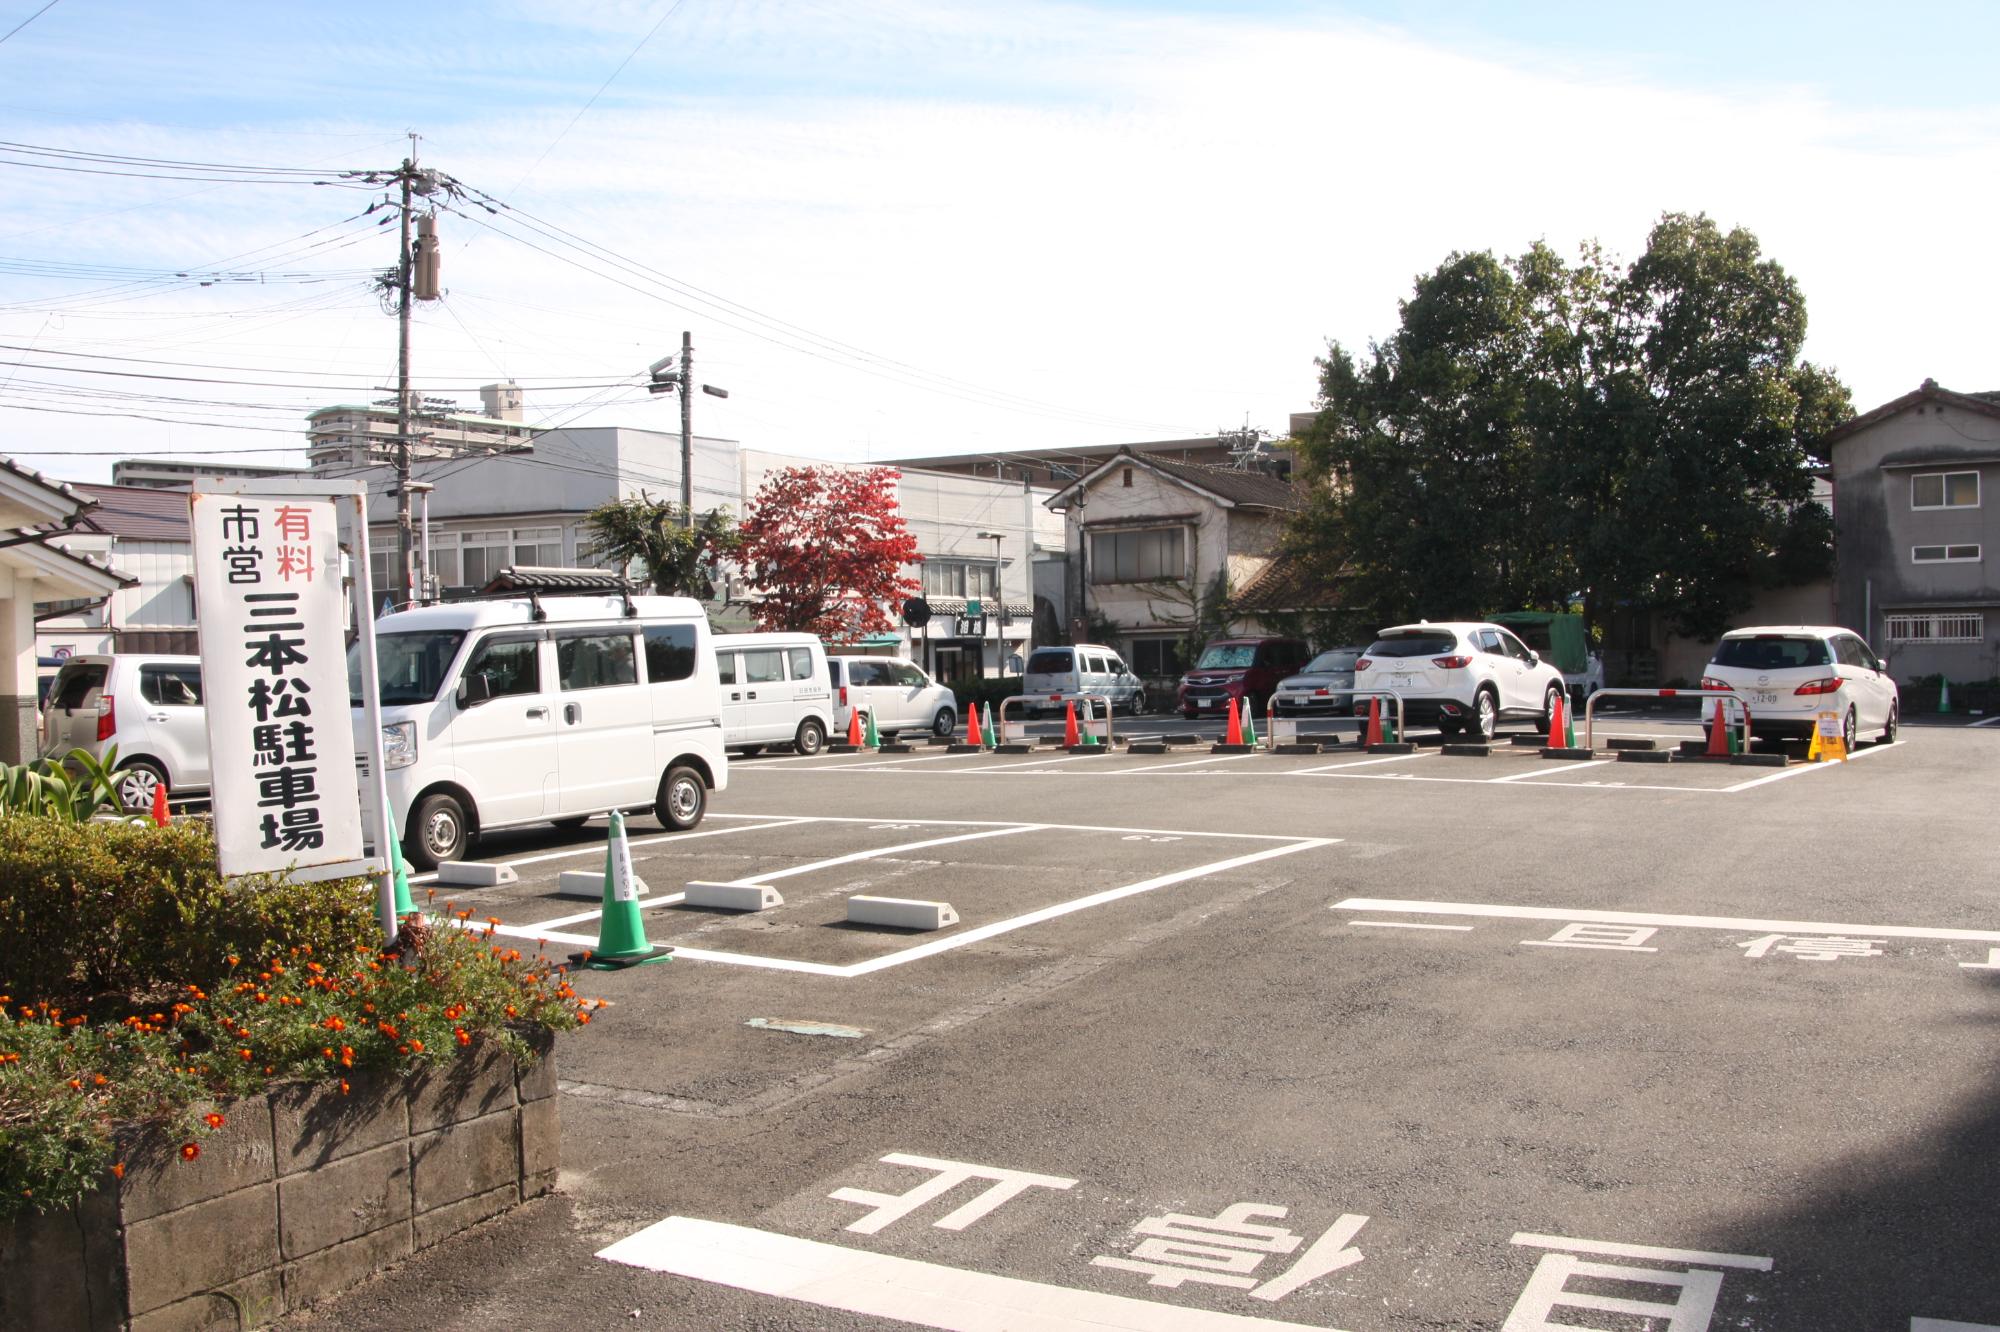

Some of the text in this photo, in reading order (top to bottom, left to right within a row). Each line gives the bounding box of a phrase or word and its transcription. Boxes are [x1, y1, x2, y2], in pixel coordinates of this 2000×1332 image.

[220, 504, 263, 584] 市営
[274, 505, 314, 582] 有料
[243, 592, 324, 852] 三本松駐車場
